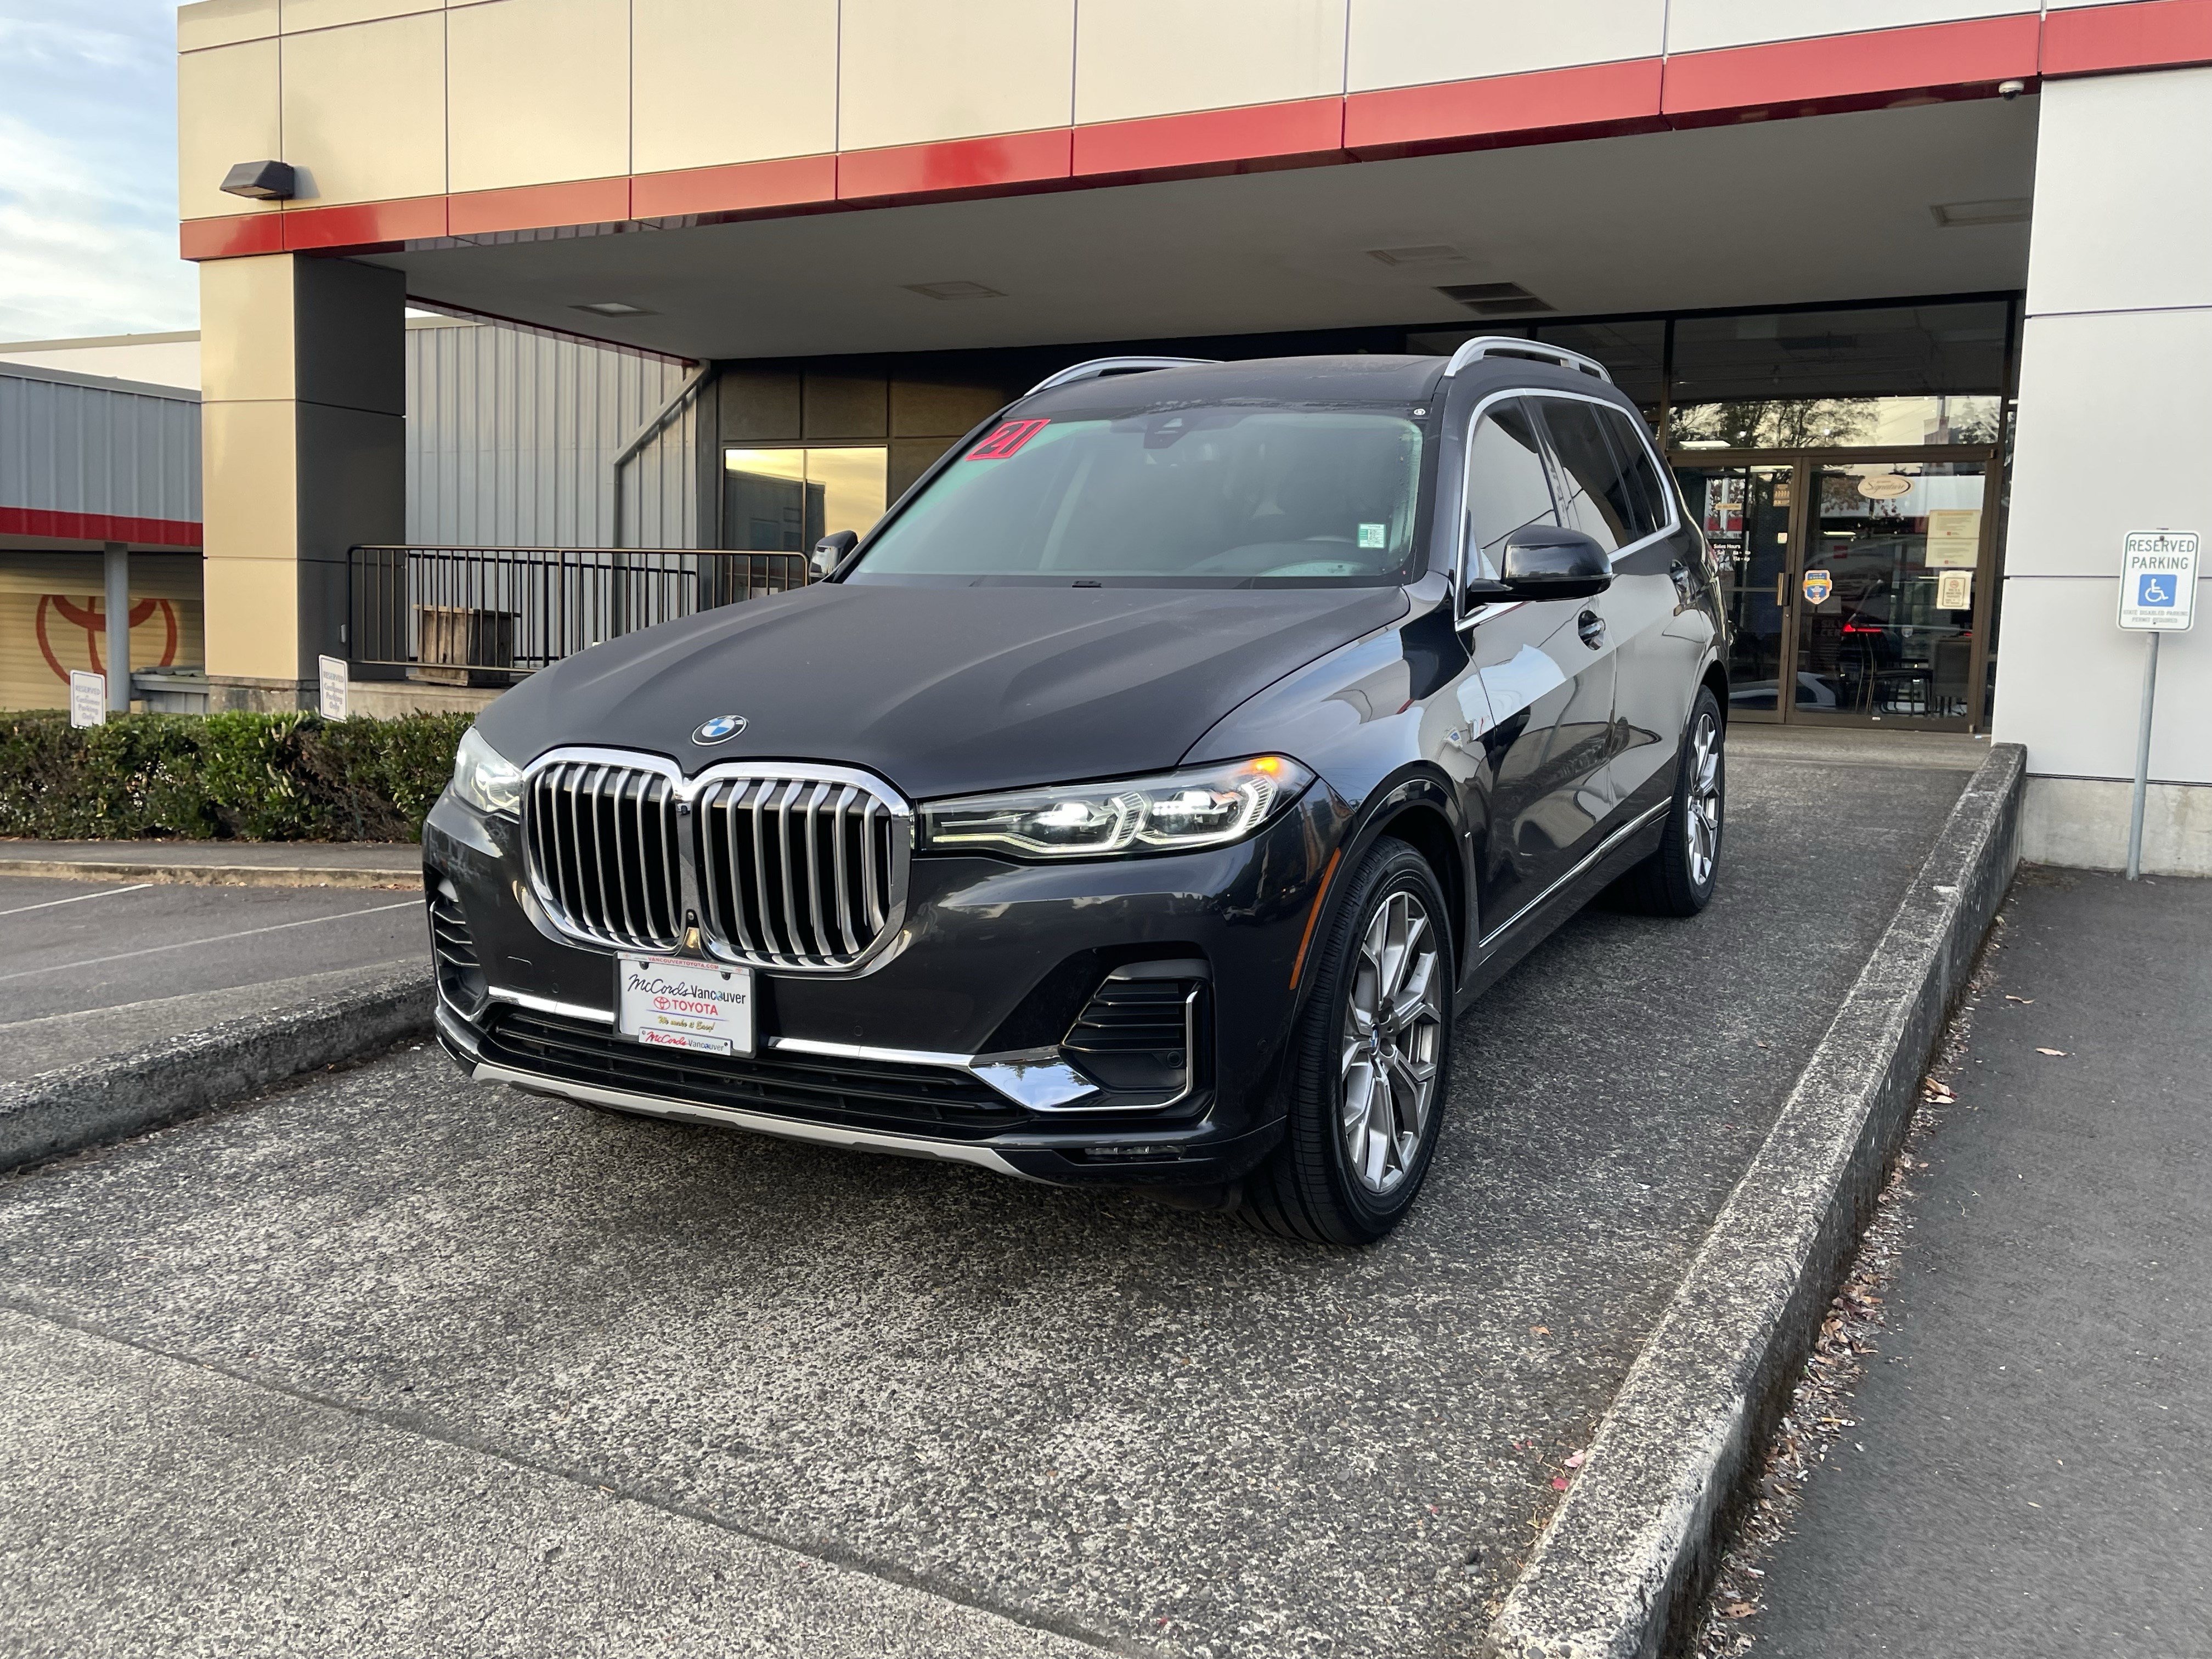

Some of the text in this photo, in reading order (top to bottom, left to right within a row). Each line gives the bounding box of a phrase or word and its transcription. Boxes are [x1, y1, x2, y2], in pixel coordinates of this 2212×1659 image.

[972, 421, 1042, 456] 21
[2128, 539, 2195, 552] RESERVED
[2131, 556, 2189, 569] PARKING
[323, 671, 344, 682] RESERVED
[76, 685, 100, 695] RESERVED
[648, 956, 719, 969] VANCOUVERTOYOTA.COM
[673, 1000, 719, 1015] TOYOTA
[658, 1015, 669, 1024] We
[670, 1019, 687, 1028] make
[696, 1021, 716, 1032] Easy!
